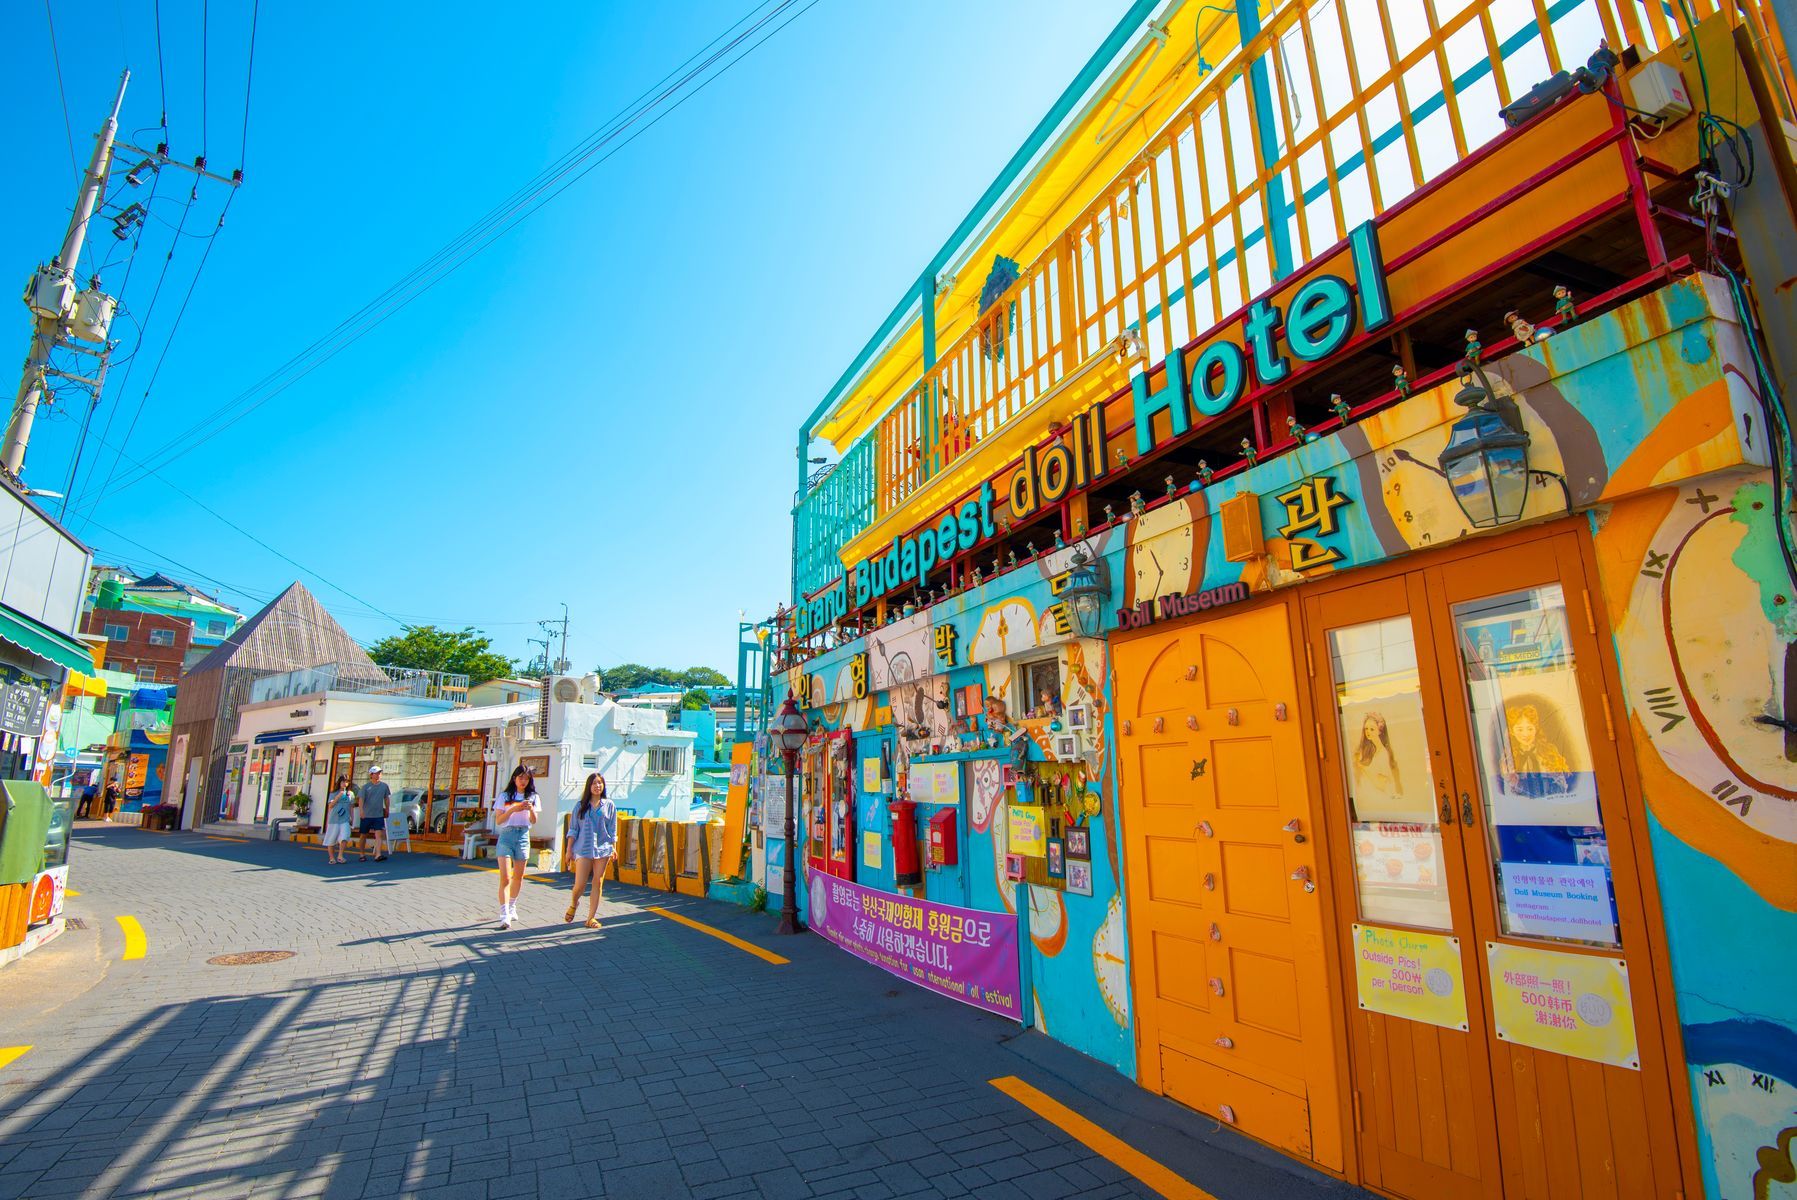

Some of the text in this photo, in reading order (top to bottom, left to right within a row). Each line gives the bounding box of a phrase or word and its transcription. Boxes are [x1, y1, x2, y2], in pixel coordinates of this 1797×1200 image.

[796, 219, 1395, 639] Grand Budapest doll Hotel
[850, 652, 869, 699] 형
[934, 624, 959, 667] 박
[1276, 476, 1354, 572] 관
[1117, 581, 1250, 632] Doll Museum
[832, 882, 992, 948] 촬영료는 부산국제인형제 후원금으로
[1514, 888, 1599, 903] Doll Museum Booking
[852, 916, 953, 972] 소중히 사용하겠습니다.
[1362, 949, 1394, 965] Outside
[1371, 977, 1385, 988] per
